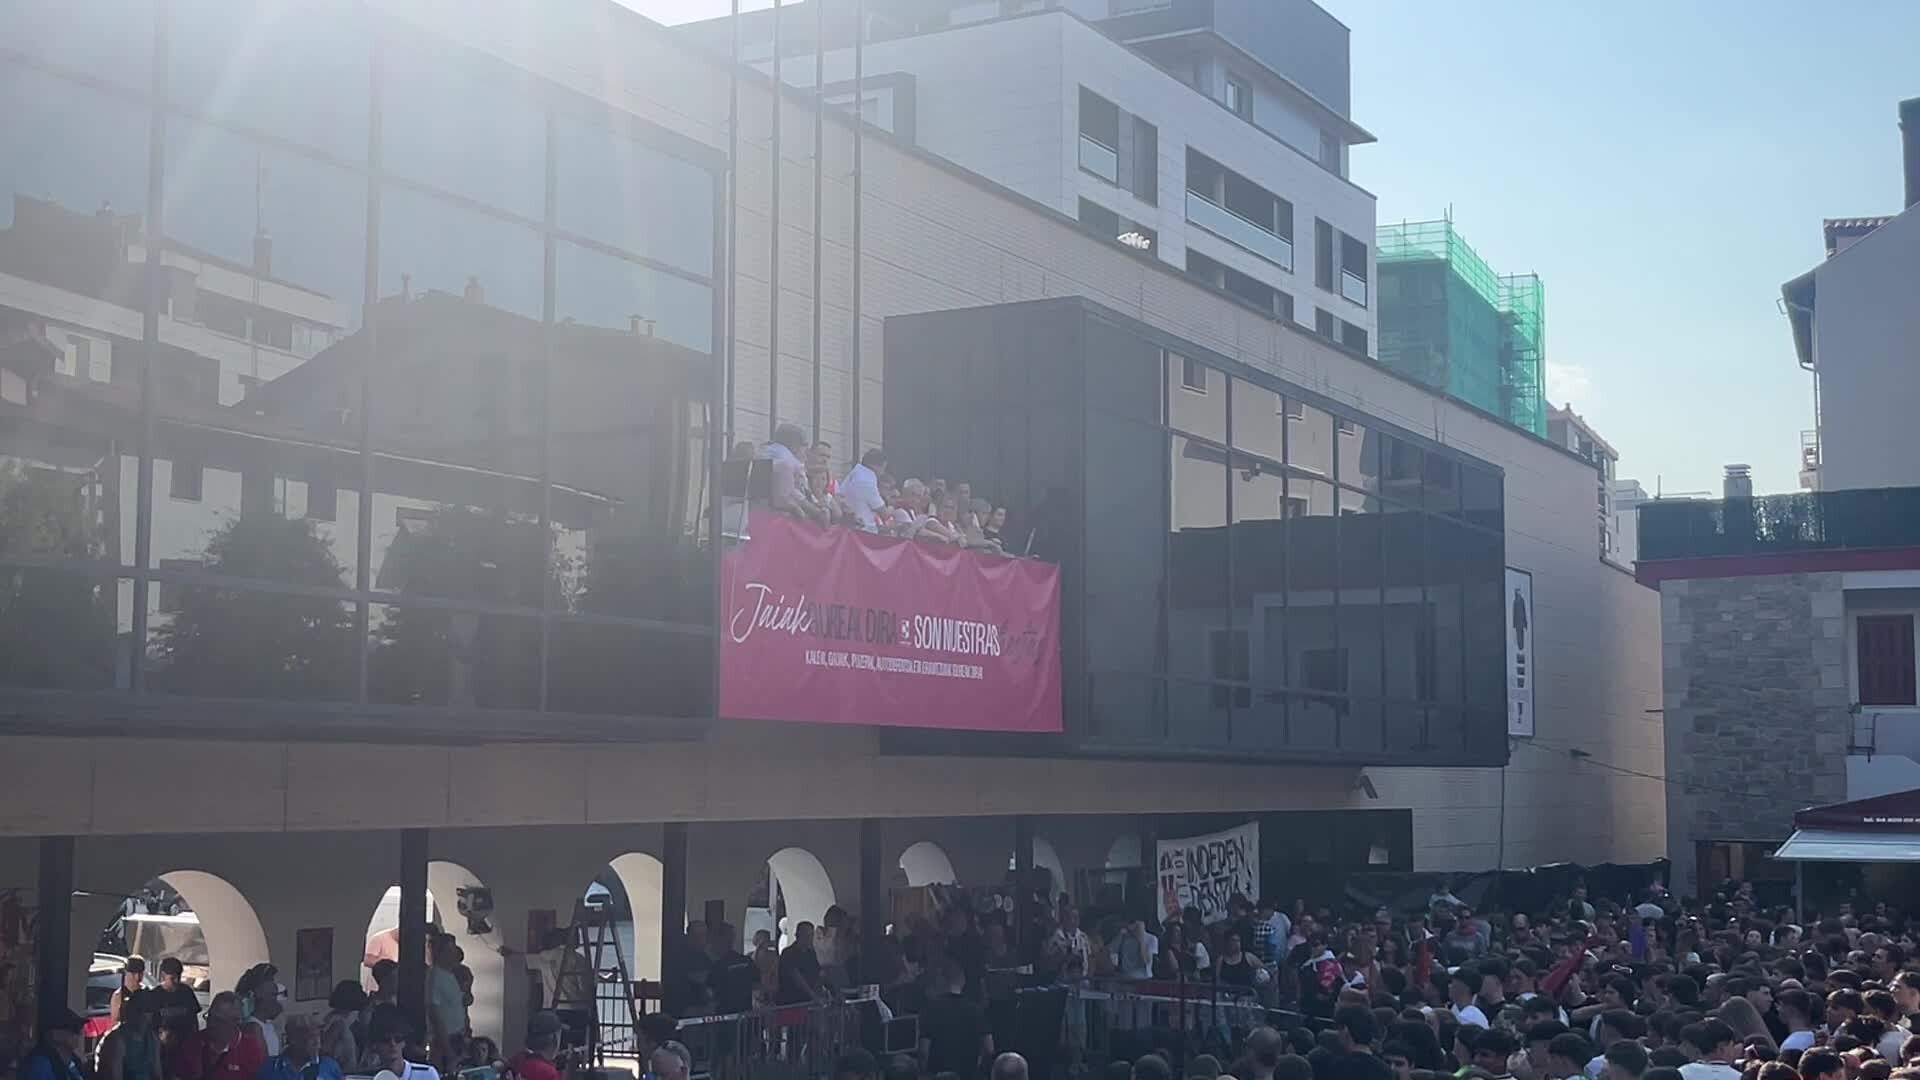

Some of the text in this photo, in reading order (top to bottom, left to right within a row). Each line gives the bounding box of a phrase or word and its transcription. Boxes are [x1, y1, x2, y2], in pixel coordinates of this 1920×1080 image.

[731, 583, 813, 643] Jaiak
[866, 609, 897, 645] DIRA
[914, 615, 942, 651] SON
[943, 618, 1001, 657] NUESTRAS
